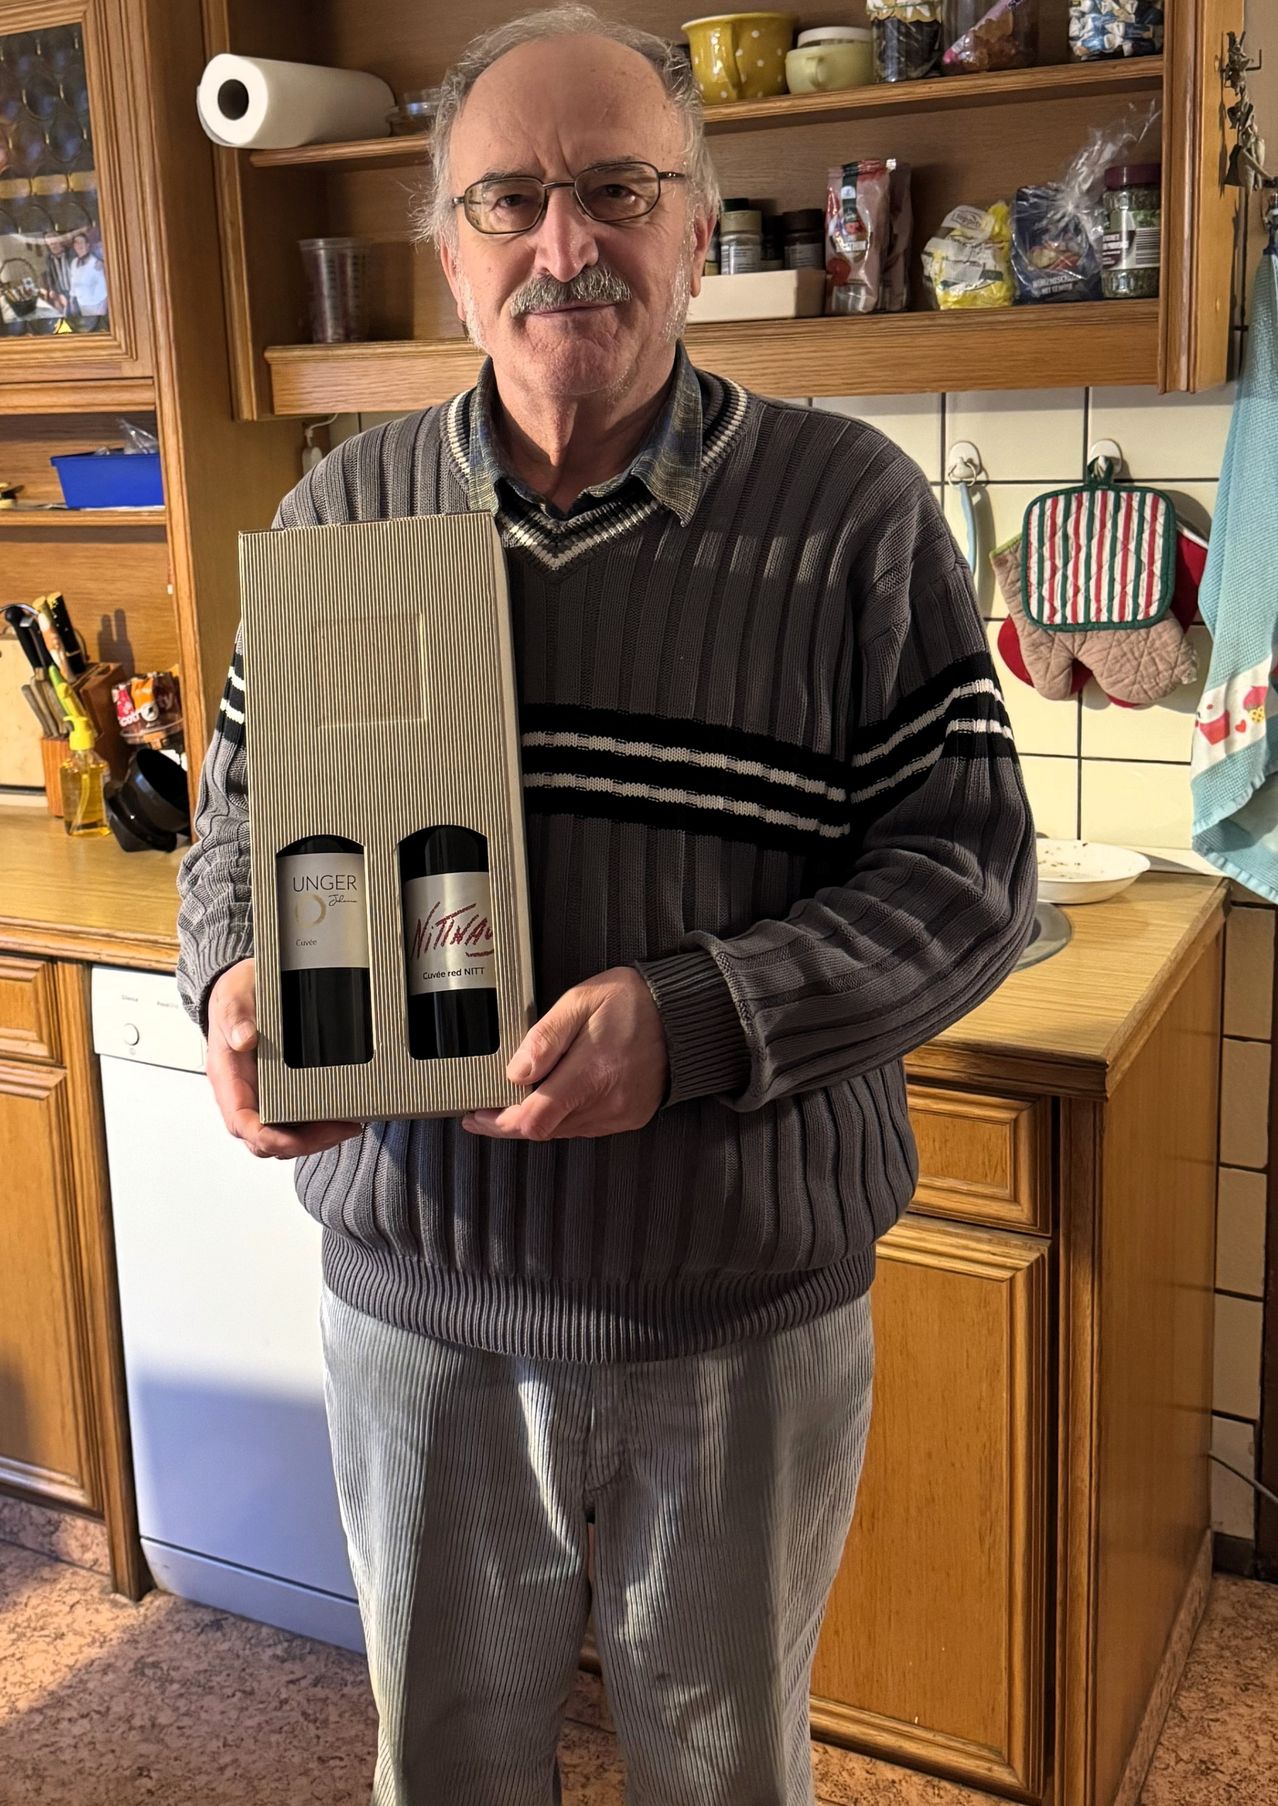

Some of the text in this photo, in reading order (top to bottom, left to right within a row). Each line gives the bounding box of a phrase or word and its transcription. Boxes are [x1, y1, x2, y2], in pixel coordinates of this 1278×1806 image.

[293, 875, 358, 892] UNGER
[296, 939, 318, 947] Cuvée
[422, 967, 485, 980] Cuvée red NITT
